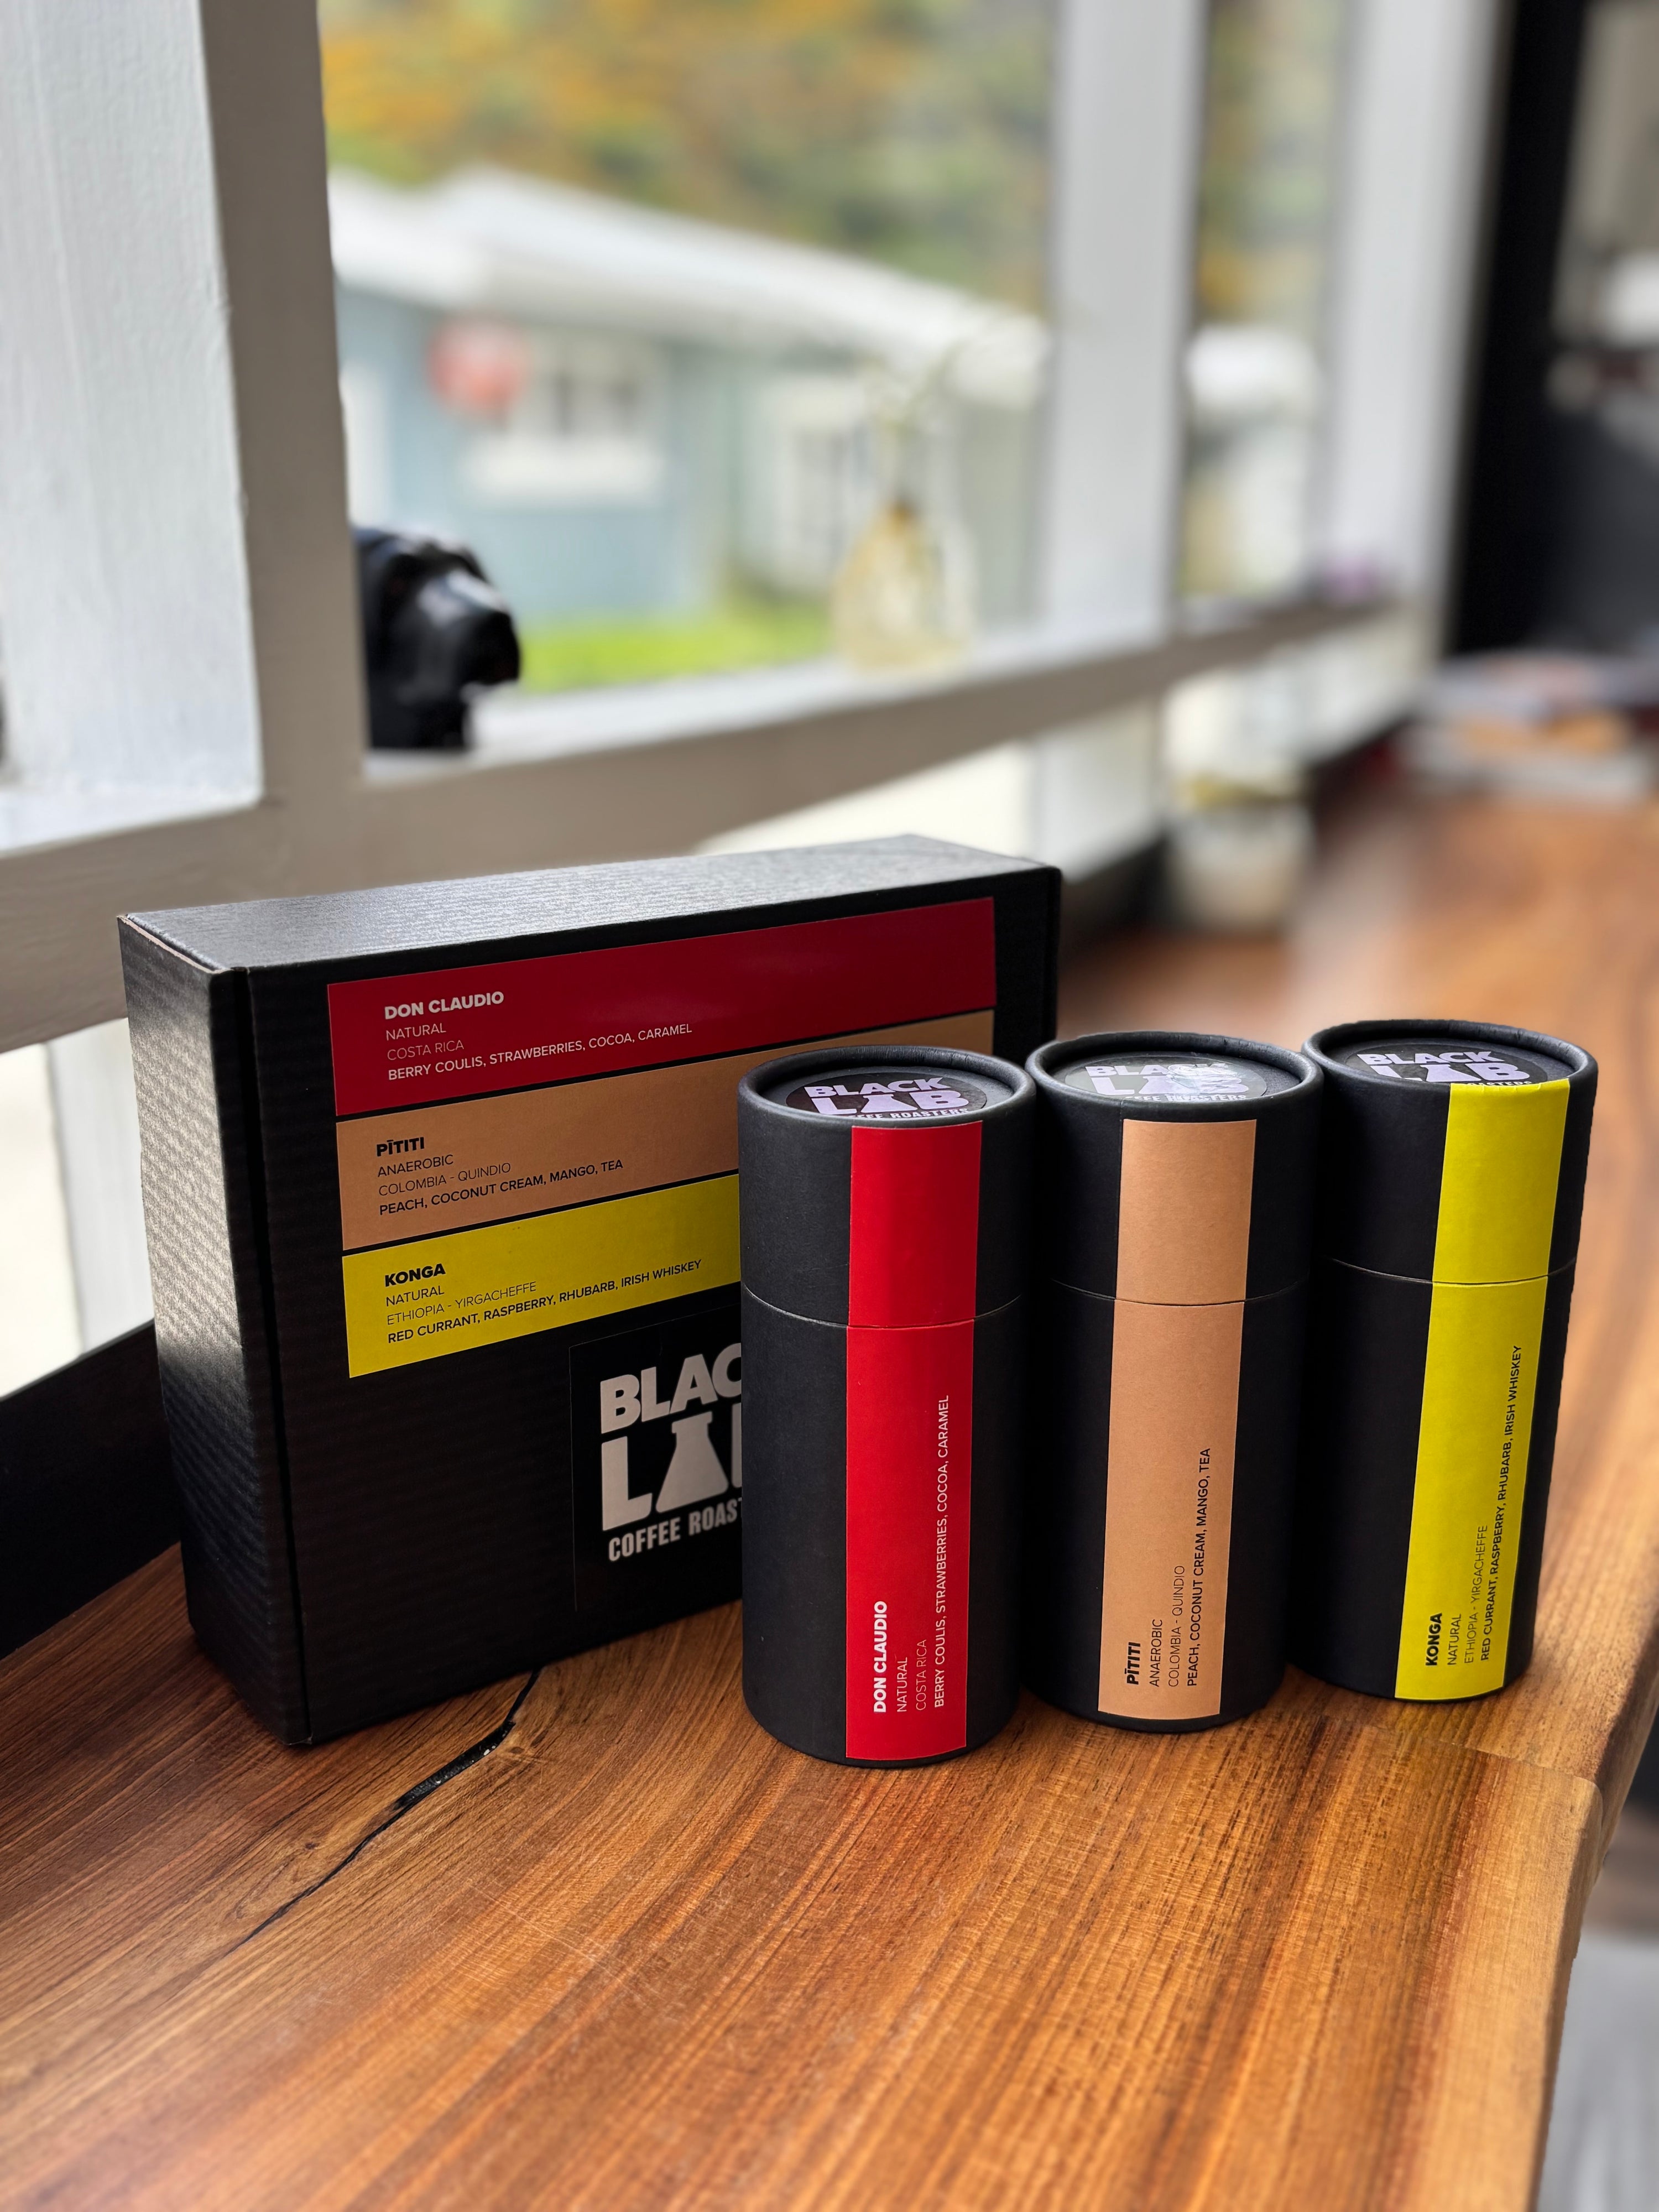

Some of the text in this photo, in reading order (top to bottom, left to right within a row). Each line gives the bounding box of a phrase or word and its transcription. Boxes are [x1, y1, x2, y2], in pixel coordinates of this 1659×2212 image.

[384, 991, 504, 1020] DON CLAUDIO
[386, 1022, 447, 1041] NATURAL
[387, 1040, 465, 1061] COSTA RICA
[388, 1024, 692, 1081] BERRY COULIS, STRAWBERRIES, COCOA, CARAMEL
[1357, 1051, 1505, 1065] BLACK
[1370, 1062, 1530, 1082] LAB
[804, 1077, 952, 1098] BLACK
[811, 1089, 969, 1115] LAB
[889, 1108, 968, 1119] ROASTERS
[378, 1154, 454, 1177] ANAEROBIC
[379, 1175, 447, 1196] COLOMBIA
[458, 1162, 511, 1181] QUINDIO
[379, 1159, 623, 1215] PEACH, COCONUT CREAM, MANGO, TEA
[384, 1263, 446, 1287] KONGA
[386, 1285, 445, 1307] NATURAL
[387, 1303, 445, 1325] ETHIOPIA
[455, 1281, 536, 1309] YIRGACHEFFE
[388, 1259, 702, 1344] RED CURRANT, RASPBERRY, RHUBARB, IRISH WHISKEY
[600, 1343, 742, 1434] BLAC
[601, 1402, 742, 1531] LA
[608, 1496, 743, 1562] COFFEE ROAS
[1480, 1345, 1521, 1661] RED CURRANT, RASPBERRY, RHUBARB, IRISH WHISKEY
[935, 1395, 949, 1708] BERRY COULIS, STRAWBERRIES, COCOA, CARAMEL
[1187, 1448, 1211, 1686] PEACH, COCONUT CREAM, MANGO, TEA
[1470, 1525, 1488, 1604] YIRGACHEFFE
[1172, 1566, 1185, 1616] QUINDIO
[873, 1600, 888, 1713] DON CLAUDIO
[1149, 1619, 1162, 1687] ANAEROBIC
[1168, 1626, 1181, 1687] COLOMBIA
[1425, 1613, 1443, 1666] KONGA
[1447, 1613, 1462, 1665] NATURAL
[1464, 1612, 1478, 1664] ETHIOPIA
[896, 1657, 907, 1713] NATURAL
[916, 1639, 927, 1711] COSTA RICA
